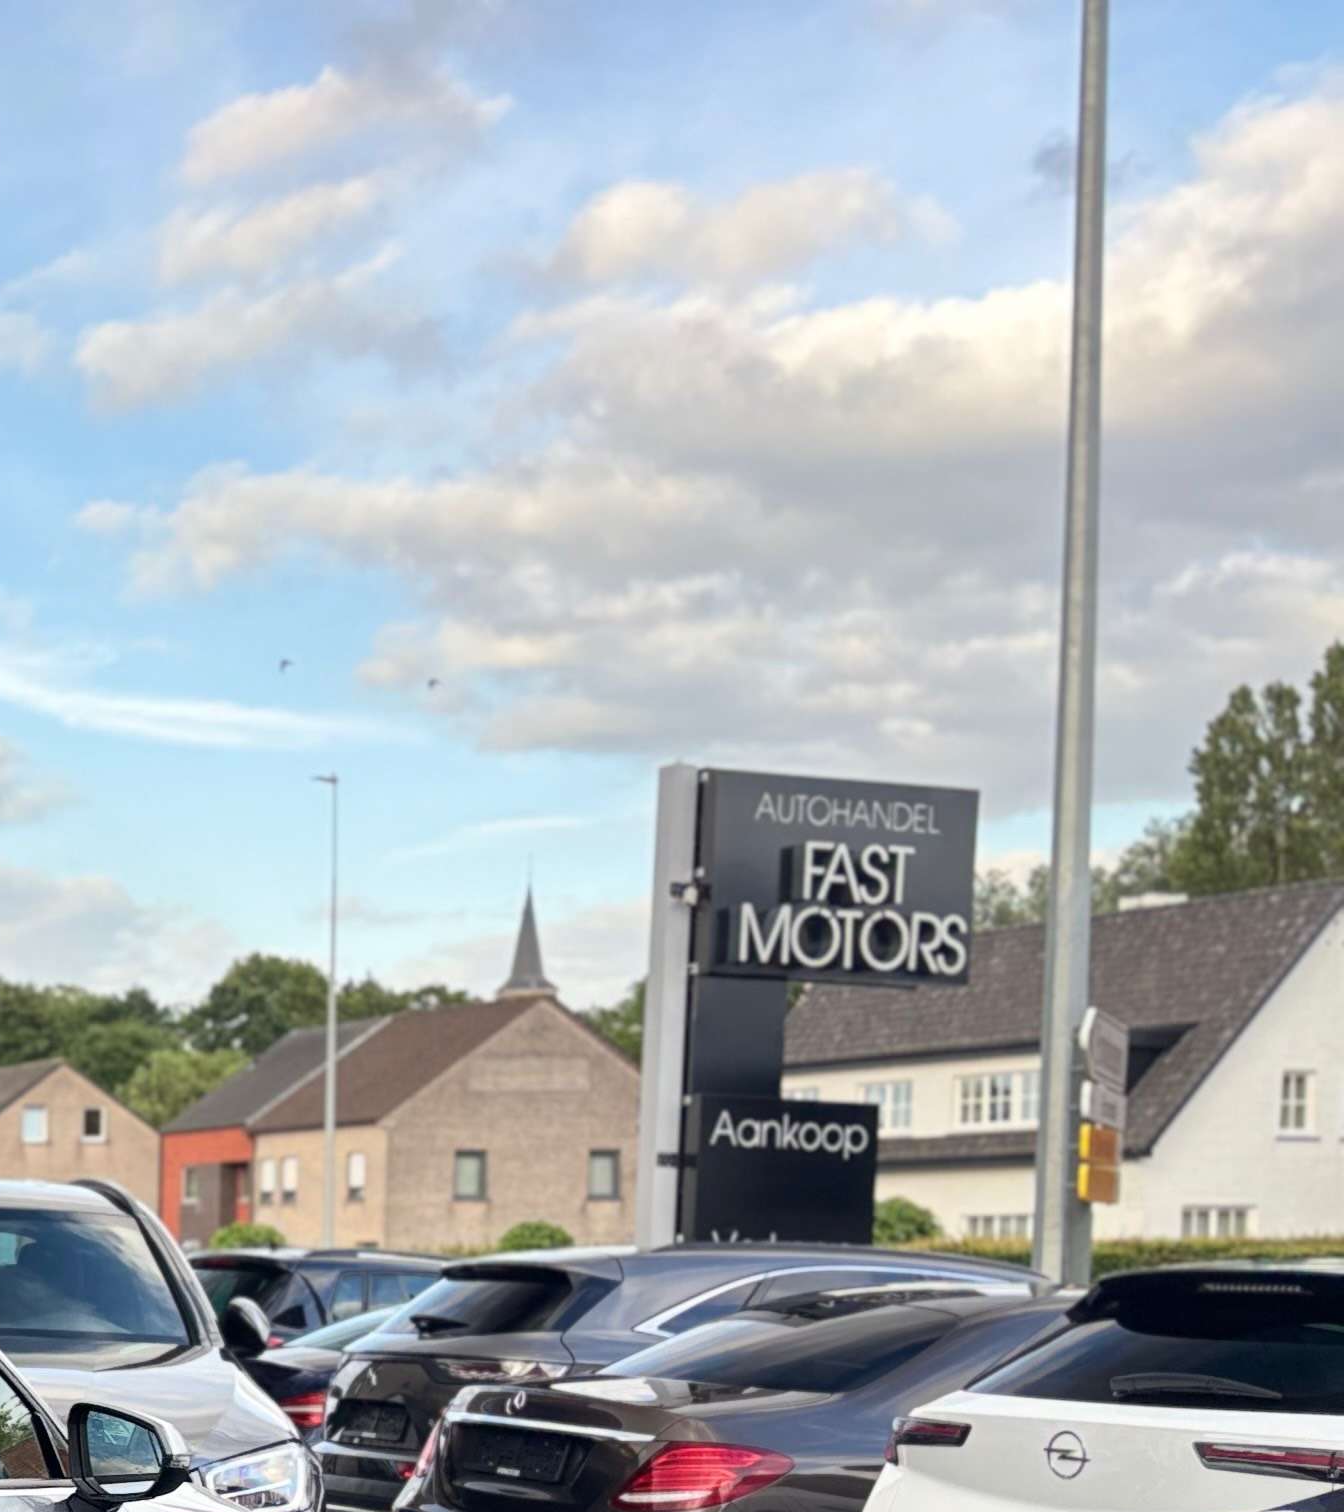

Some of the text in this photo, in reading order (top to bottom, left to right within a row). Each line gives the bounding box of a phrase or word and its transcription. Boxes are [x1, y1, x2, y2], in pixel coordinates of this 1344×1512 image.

[754, 793, 941, 835] AUTOHANDEL
[802, 841, 916, 905] FAST
[739, 902, 967, 975] MOTORS
[710, 1110, 870, 1159] Aankoop
